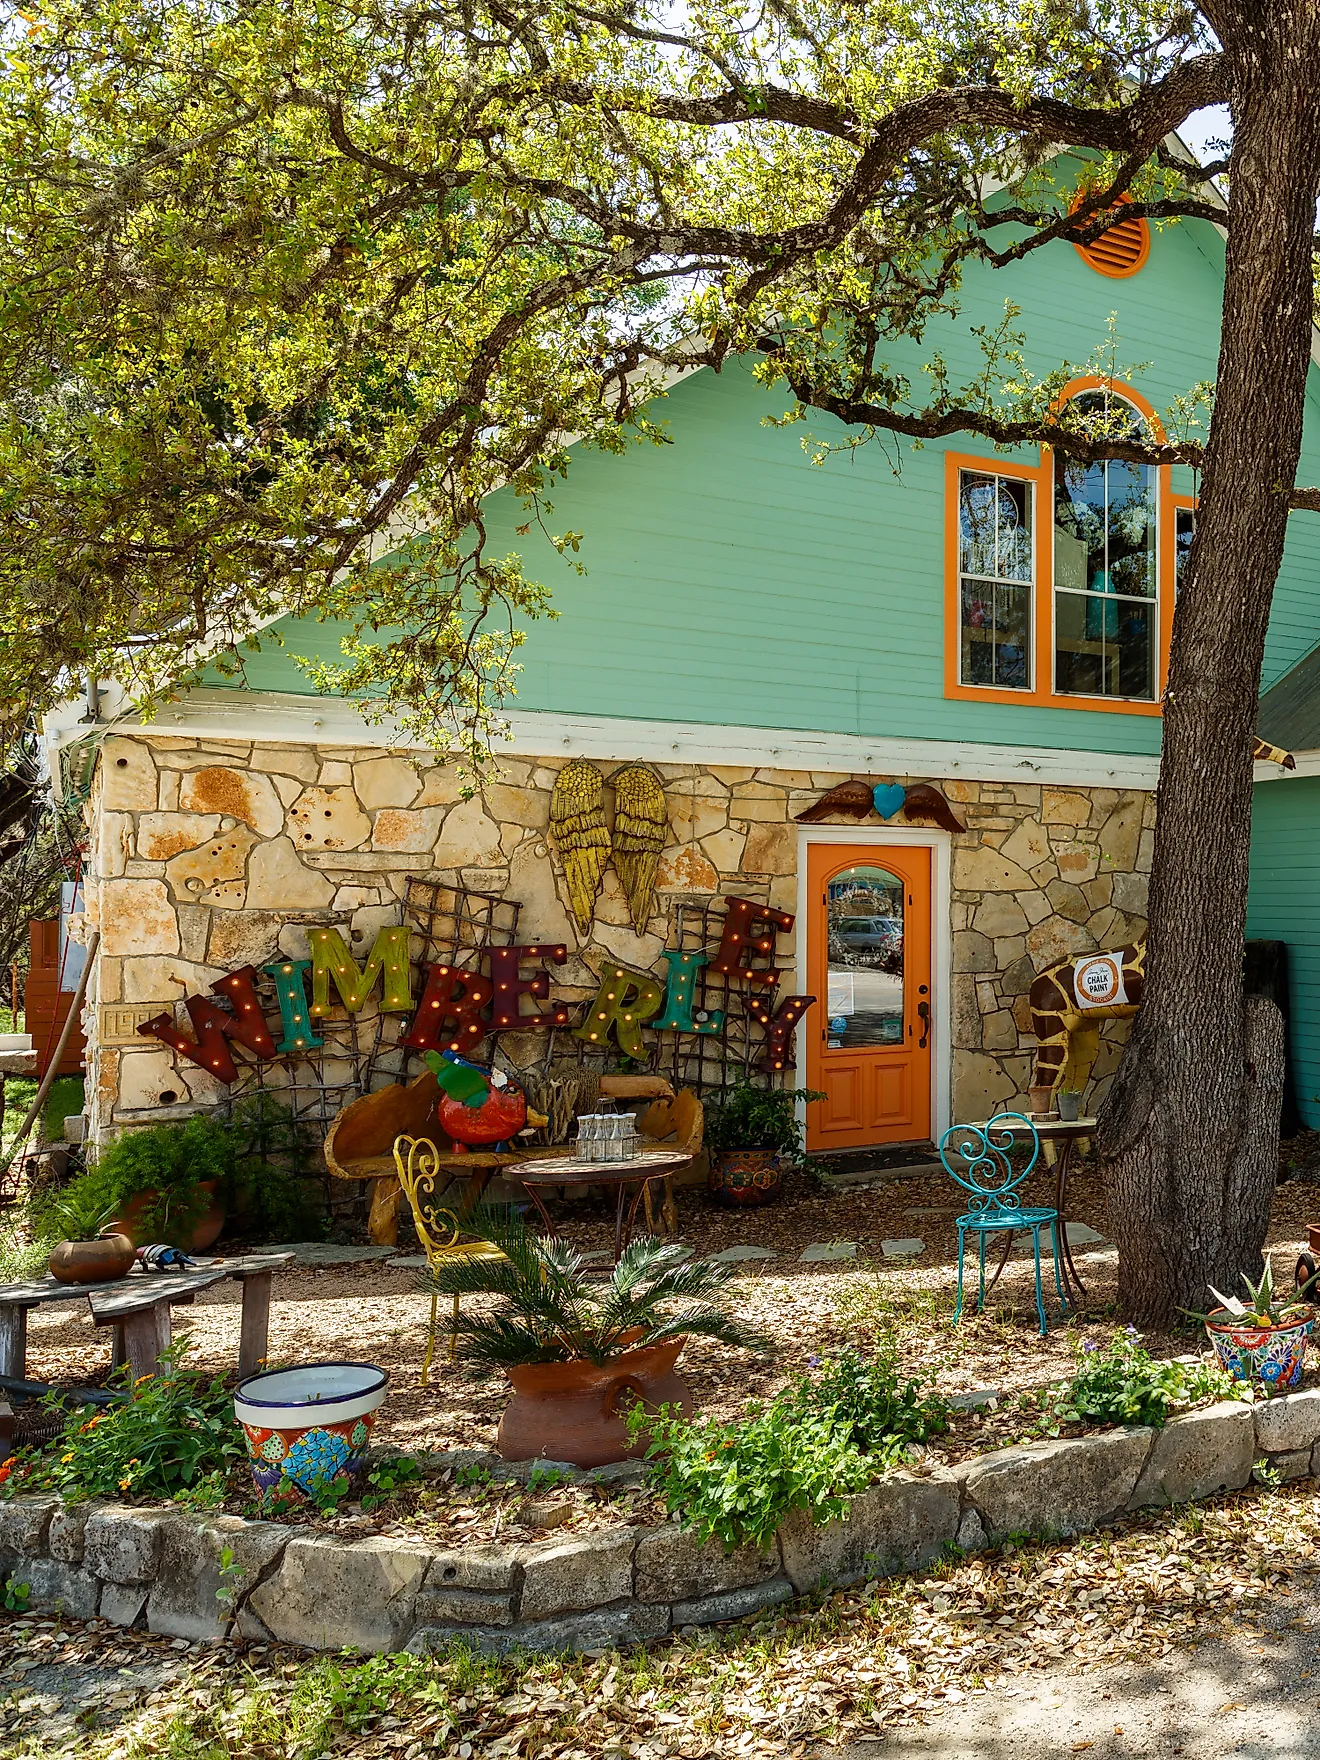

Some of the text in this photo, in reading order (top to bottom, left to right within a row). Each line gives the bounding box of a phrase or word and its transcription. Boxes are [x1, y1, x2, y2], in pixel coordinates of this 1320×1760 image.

[1087, 974, 1109, 985] CHALK
[137, 896, 817, 1083] WIMBERLEY
[1089, 983, 1108, 993] PAINT
